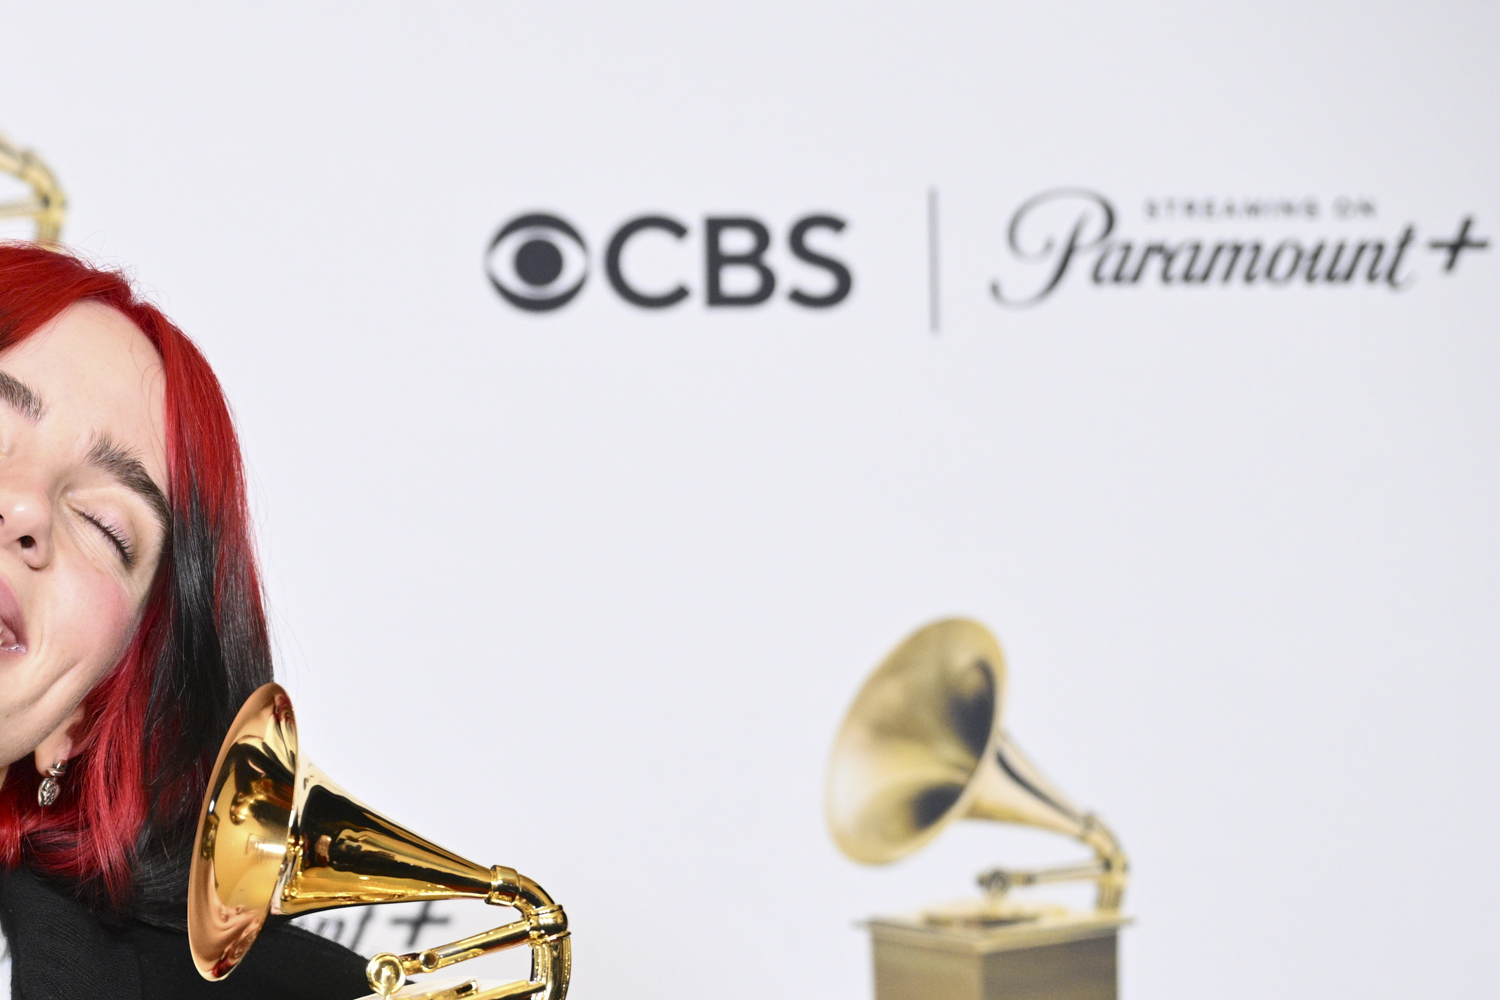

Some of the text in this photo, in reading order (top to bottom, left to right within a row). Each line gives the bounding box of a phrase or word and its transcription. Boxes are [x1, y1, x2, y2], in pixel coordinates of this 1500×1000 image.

[989, 189, 1492, 306] Paramount+
[1143, 197, 1378, 221] STREAMING ON
[602, 212, 855, 312] CBS
